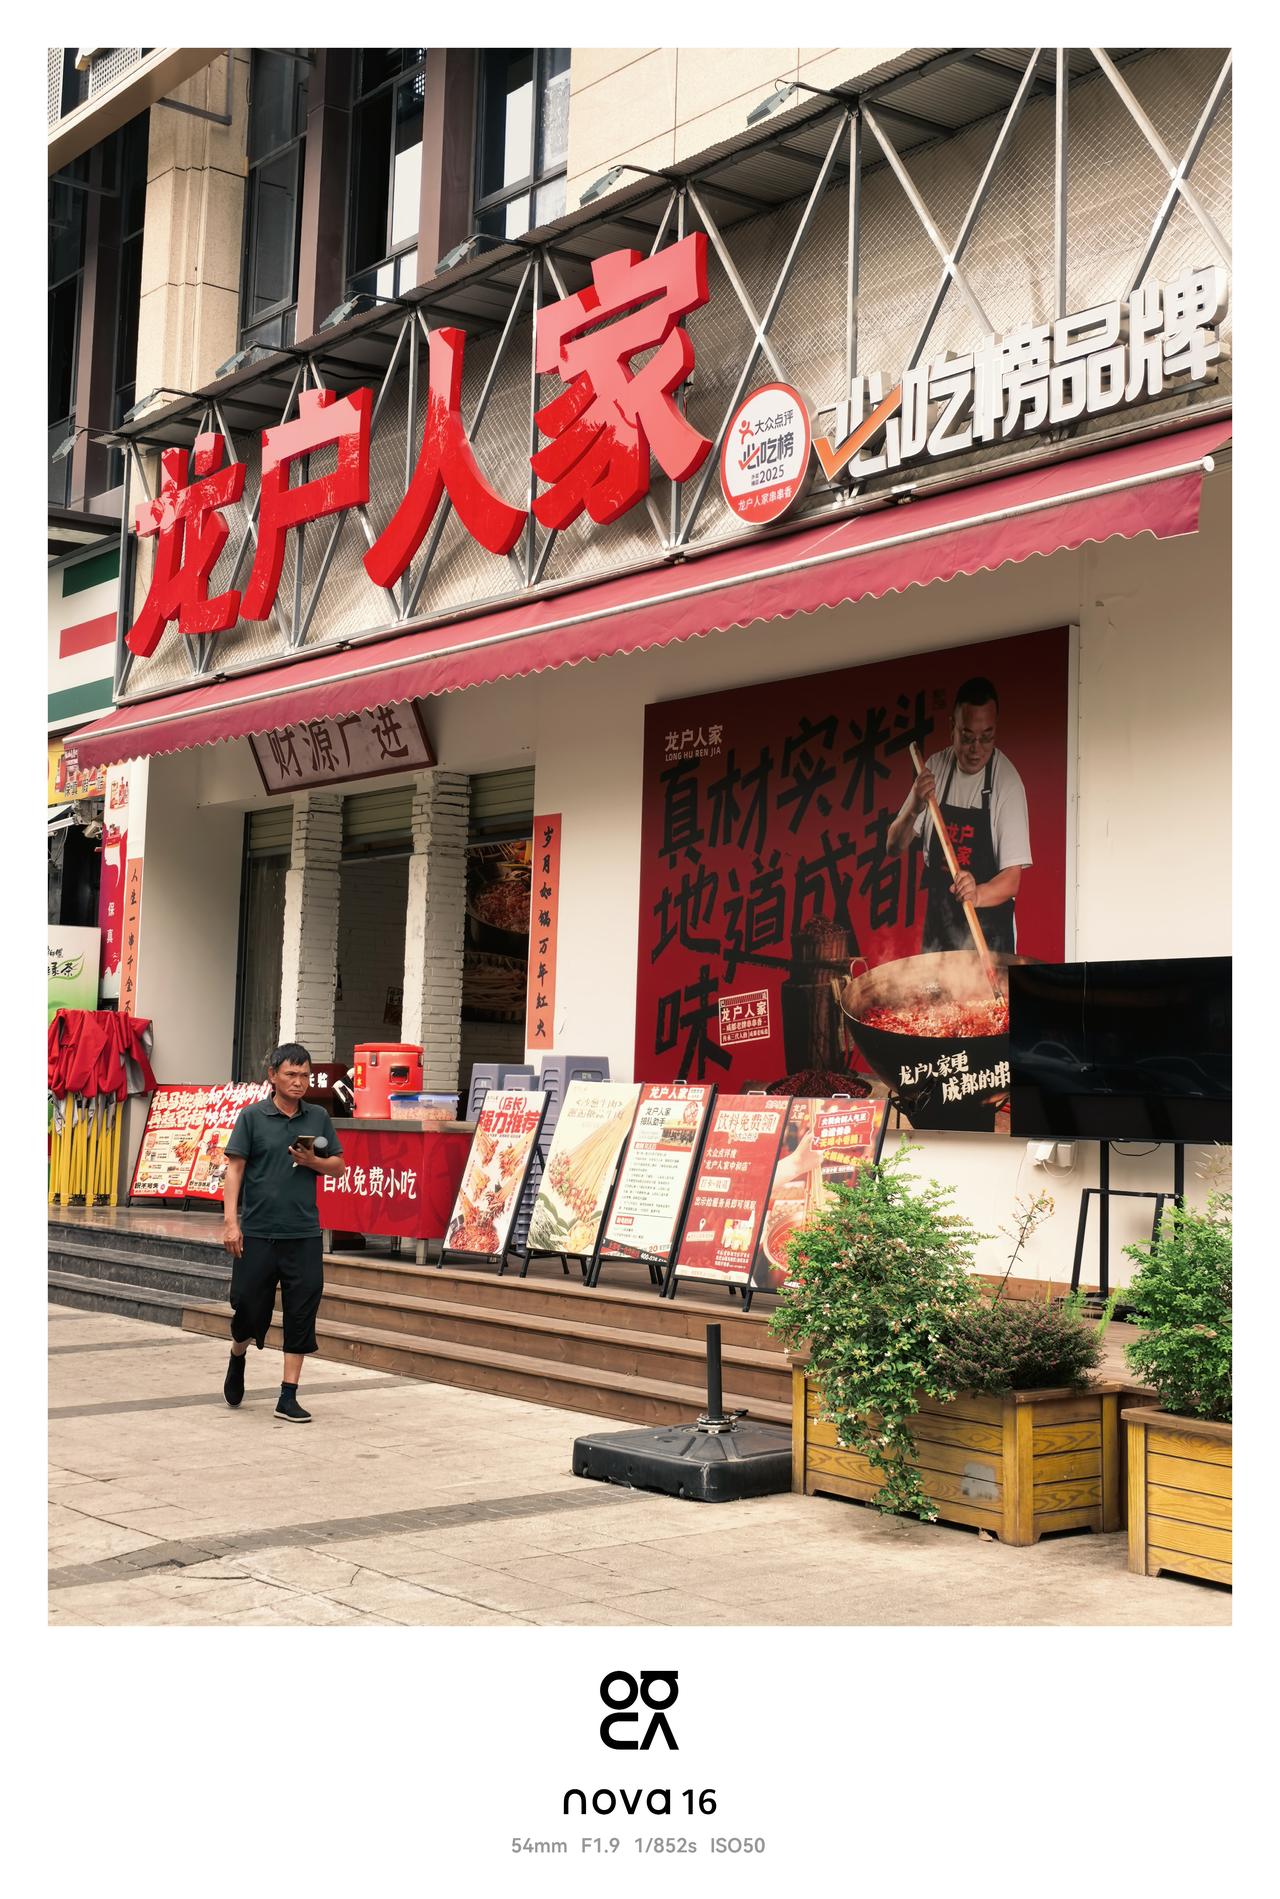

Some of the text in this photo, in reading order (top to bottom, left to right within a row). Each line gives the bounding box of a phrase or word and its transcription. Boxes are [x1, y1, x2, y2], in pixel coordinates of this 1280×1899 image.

[813, 266, 1231, 482] 必吃榜品牌
[755, 409, 794, 436] 大众点评
[125, 231, 713, 659] 龙户人家
[738, 431, 794, 471] 必吃榜
[759, 465, 785, 484] 2025
[737, 486, 793, 512] 龙户人家串串香
[267, 704, 409, 780] 财源广进
[665, 725, 722, 751] 龙户人家
[665, 747, 721, 761] LONG HU REN JIA
[657, 690, 934, 869] 真材实料
[651, 808, 926, 984] 地道成都
[48, 946, 63, 958] 师傅
[655, 964, 733, 1080] 味
[721, 1001, 767, 1022] 龙户人家
[899, 1050, 969, 1086] 龙户人家更
[648, 1086, 688, 1099] 龙户人家
[942, 1061, 1010, 1104] 成都的串
[498, 1096, 527, 1111] (店长)
[645, 1107, 671, 1117] 龙户人家
[479, 1110, 542, 1134] 强力推荐
[323, 1165, 417, 1199] 自取免费小吃
